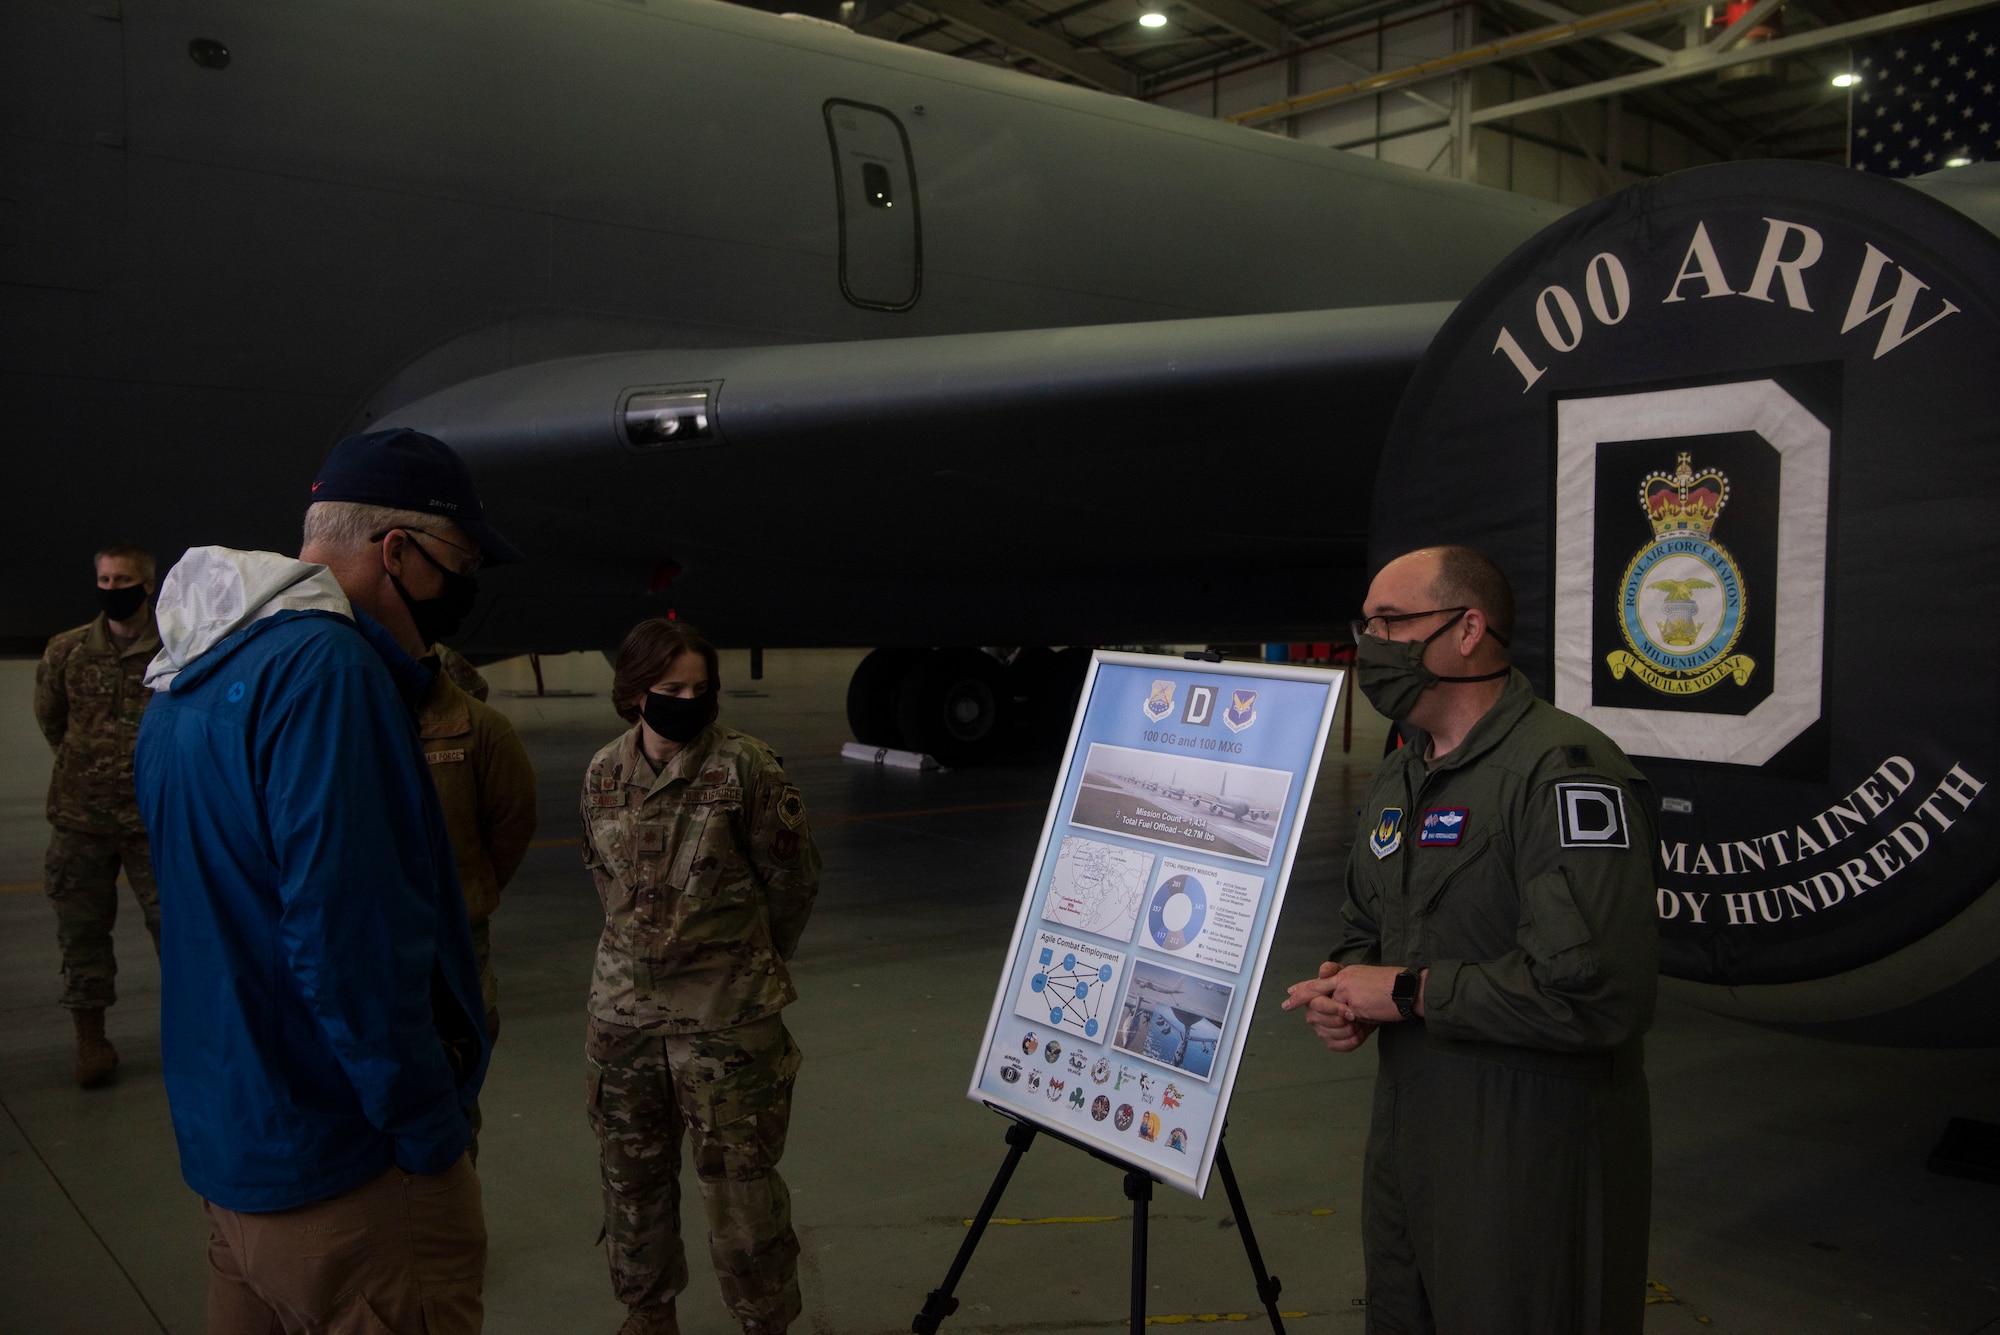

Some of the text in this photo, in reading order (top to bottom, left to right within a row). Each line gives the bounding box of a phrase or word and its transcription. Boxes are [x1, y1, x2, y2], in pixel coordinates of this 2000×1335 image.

[1493, 217, 1961, 393] 100 ARW
[1627, 541, 1738, 608] ROYAL AIR FORCE STATION
[1640, 640, 1720, 668] MILDENHALL
[1622, 654, 1742, 692] UT AQUILAE VOLENT
[1187, 687, 1211, 723] D
[439, 751, 460, 761] FORCE
[1143, 731, 1242, 754] 100 OG and 100 MXG
[1122, 815, 1137, 826] Total
[1138, 819, 1152, 829] Fuel
[1154, 822, 1178, 834] Offload
[1184, 828, 1204, 840] 42.7M
[1205, 831, 1215, 841] lbs
[1136, 807, 1160, 819] Mission
[1162, 812, 1182, 823] Count
[1189, 817, 1206, 827] 1,434
[1566, 790, 1618, 841] D
[1661, 755, 1915, 875] MAINTAINED
[1721, 761, 1987, 925] HUNDREDTH
[1178, 864, 1197, 873] PRIORITY
[1198, 869, 1218, 877] MISSIONS
[1041, 933, 1056, 943] Agile
[1057, 938, 1080, 951] Combat
[1081, 944, 1119, 962] Employment
